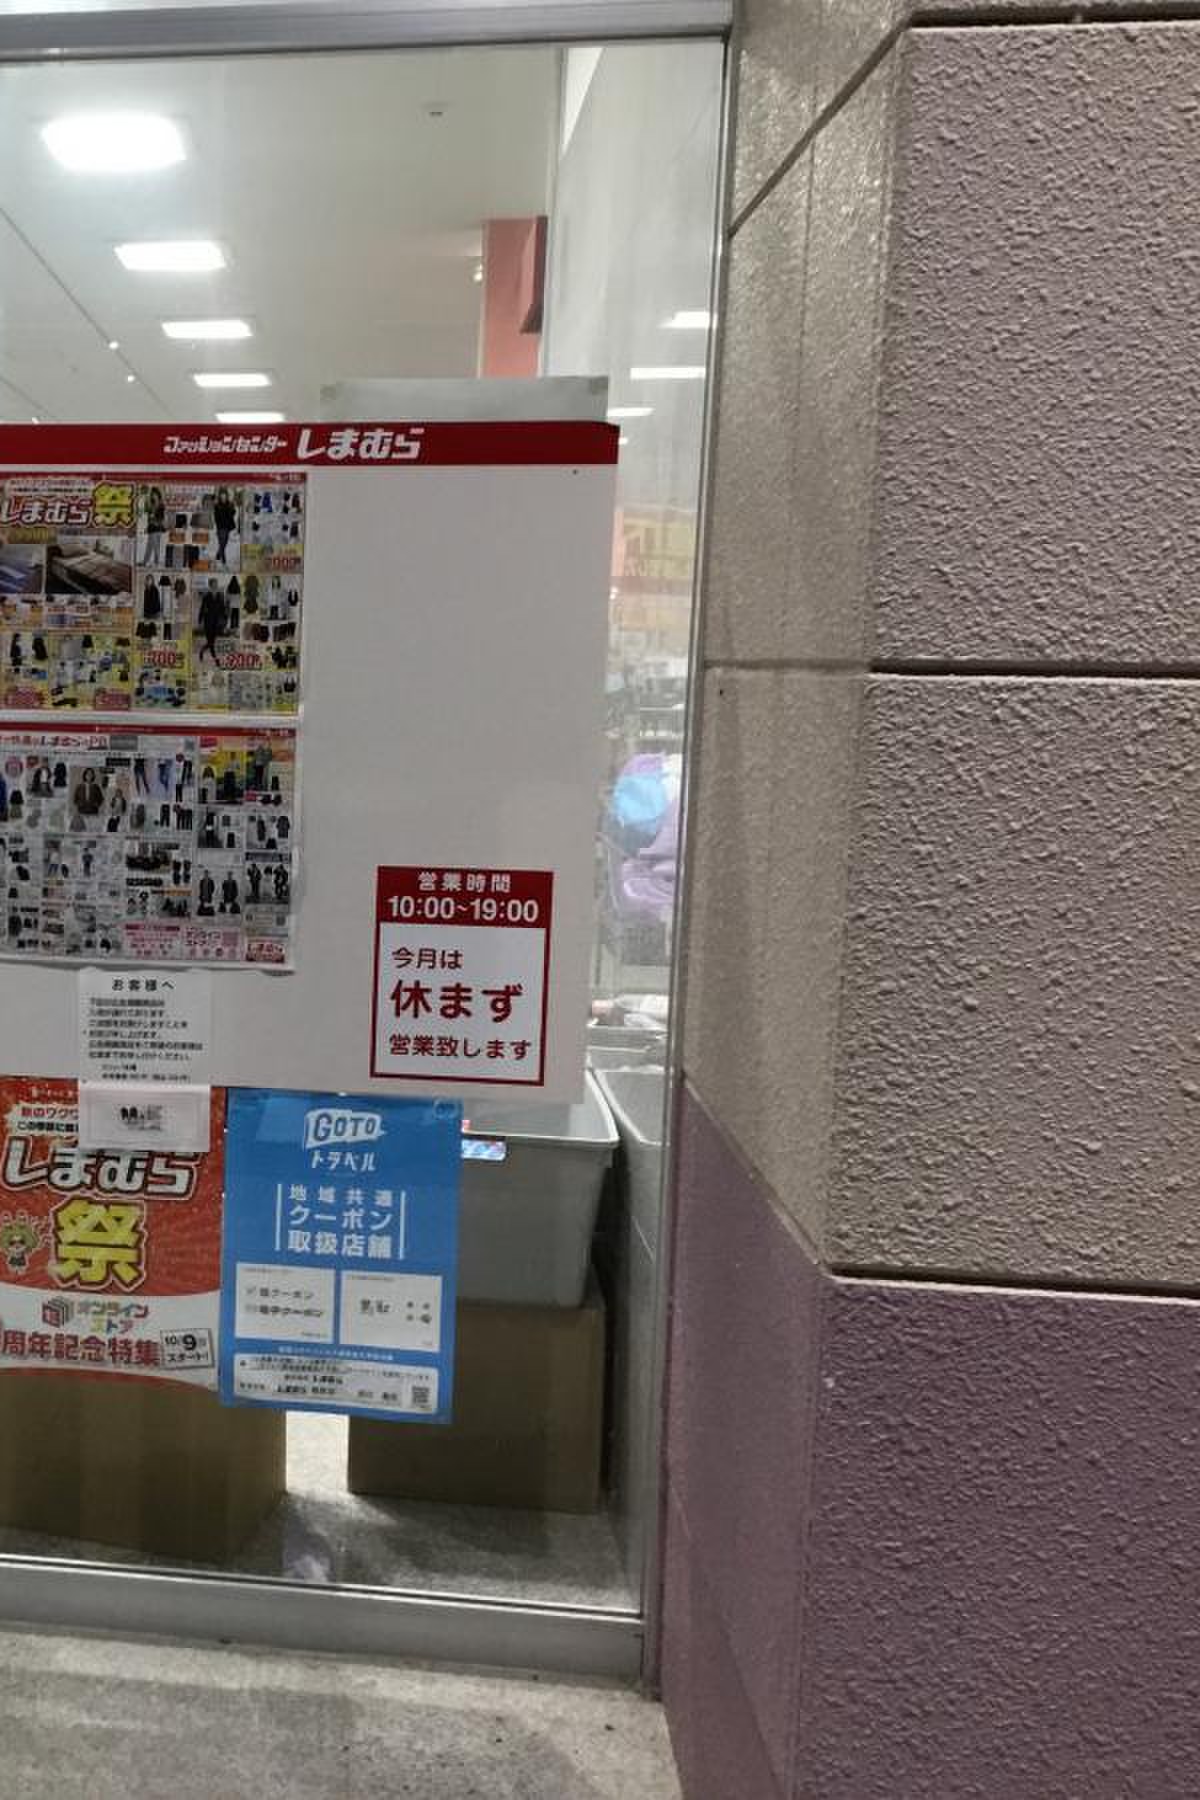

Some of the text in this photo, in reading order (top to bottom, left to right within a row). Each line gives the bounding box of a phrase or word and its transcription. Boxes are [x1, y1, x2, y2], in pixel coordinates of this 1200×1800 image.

[163, 428, 425, 459] ファッションセンター しまむら
[418, 872, 512, 893] 営業時間
[392, 946, 464, 970] 今月は
[111, 978, 175, 991] お客様へ
[390, 979, 524, 1023] 休まず
[389, 1034, 532, 1060] 営業致します
[4, 1138, 194, 1194] しまむら
[311, 1150, 376, 1172] トラベル
[289, 1184, 393, 1208] 地域共通
[289, 1207, 393, 1232] クーポン
[54, 1198, 142, 1286] 祭
[288, 1230, 393, 1259] 取扱店舗
